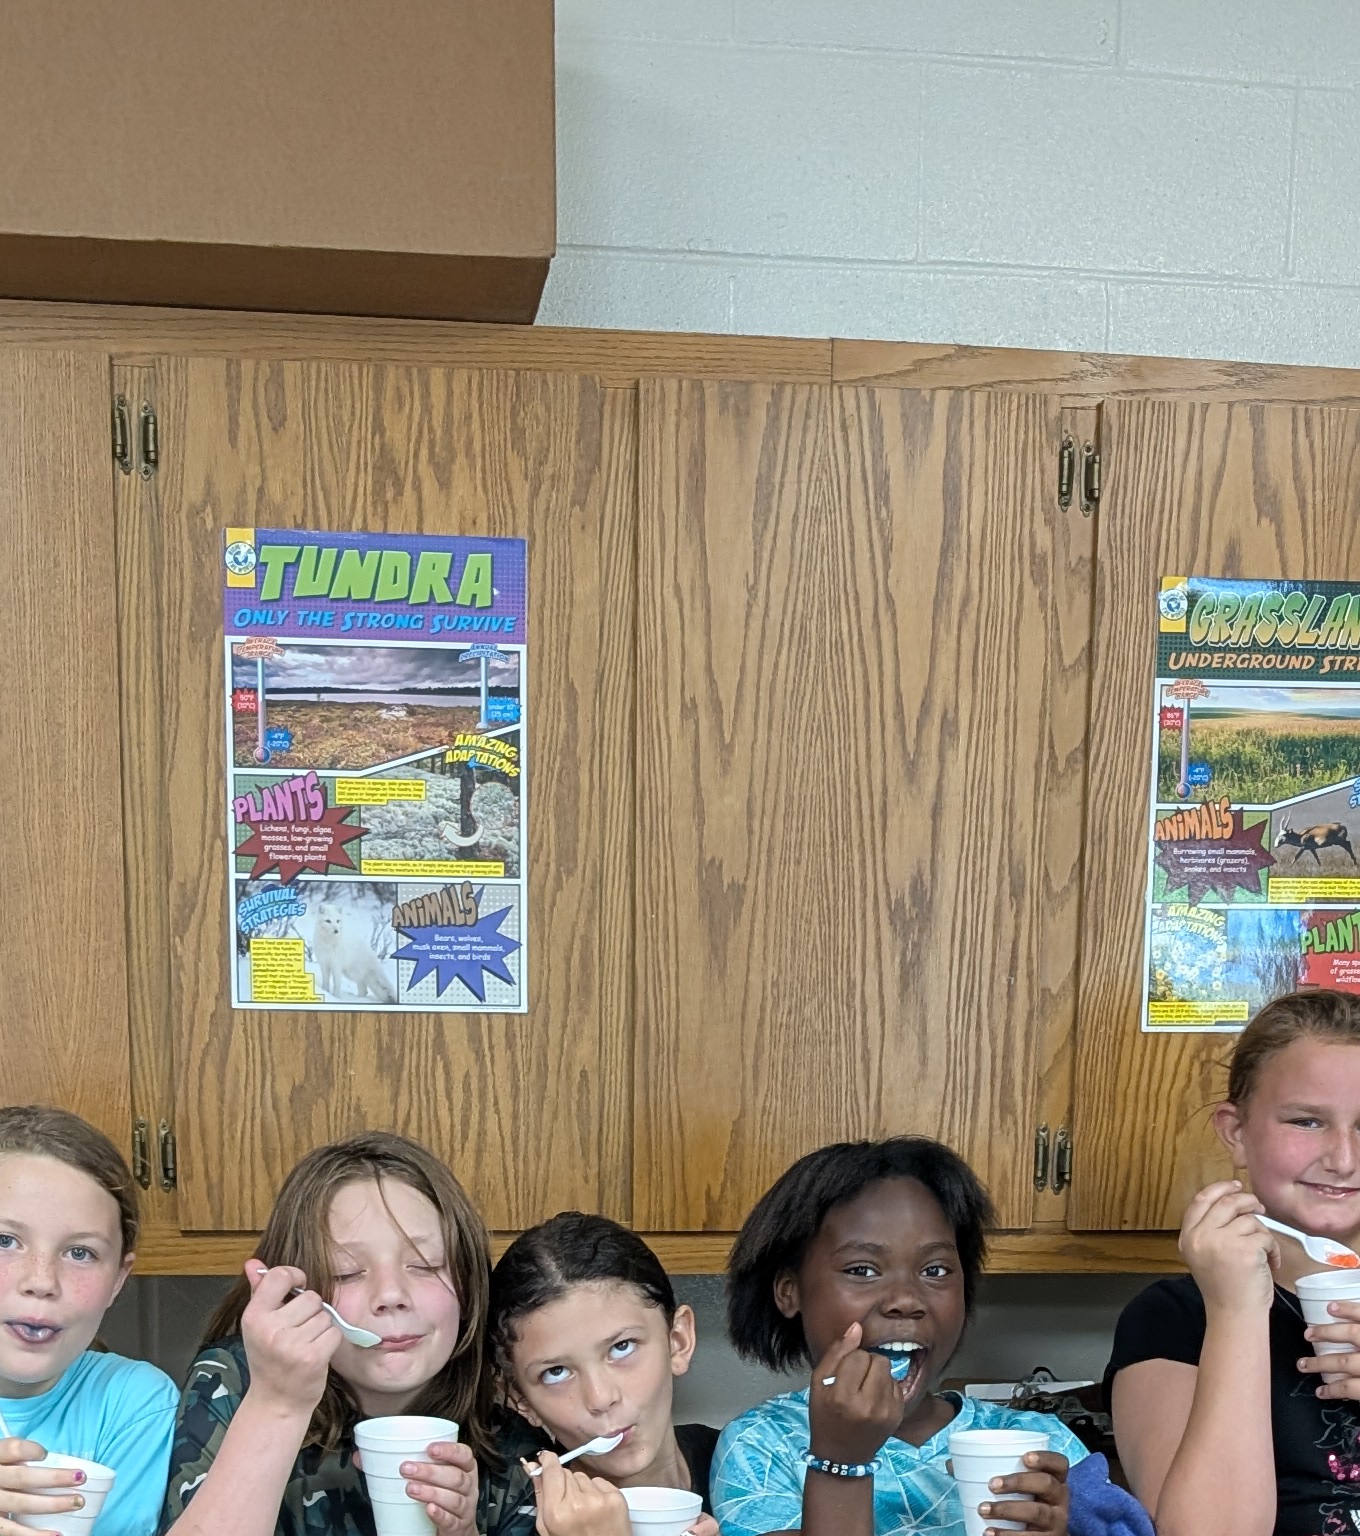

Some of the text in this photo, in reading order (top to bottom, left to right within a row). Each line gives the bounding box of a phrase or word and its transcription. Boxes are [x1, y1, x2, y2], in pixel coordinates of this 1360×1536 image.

[259, 544, 493, 608] TUNDRA
[233, 608, 517, 634] ONLY THE STRONG SURVIVE
[1168, 652, 1316, 670] UNDERGROUND
[454, 734, 518, 758] AMAZING
[445, 750, 521, 777] ADAPTATIONS
[233, 770, 324, 822] PLANTS
[260, 824, 334, 834] Lichens, fungi, algae,
[1154, 795, 1234, 841] ANIMALS
[261, 834, 333, 844] mosses, low-growing
[264, 845, 294, 853] grasses,
[269, 853, 326, 862] flowering plants
[239, 888, 298, 916] SURVIVAL
[392, 881, 478, 927] ANIMALS
[241, 903, 306, 934] STRATEGIES
[1167, 905, 1225, 926] AMAZING
[434, 934, 484, 943] Bears, wolves,
[1159, 920, 1227, 945] ADAPTATIONS
[429, 953, 457, 961] insects,
[472, 944, 506, 952] mammals,
[1332, 959, 1350, 967] Many
